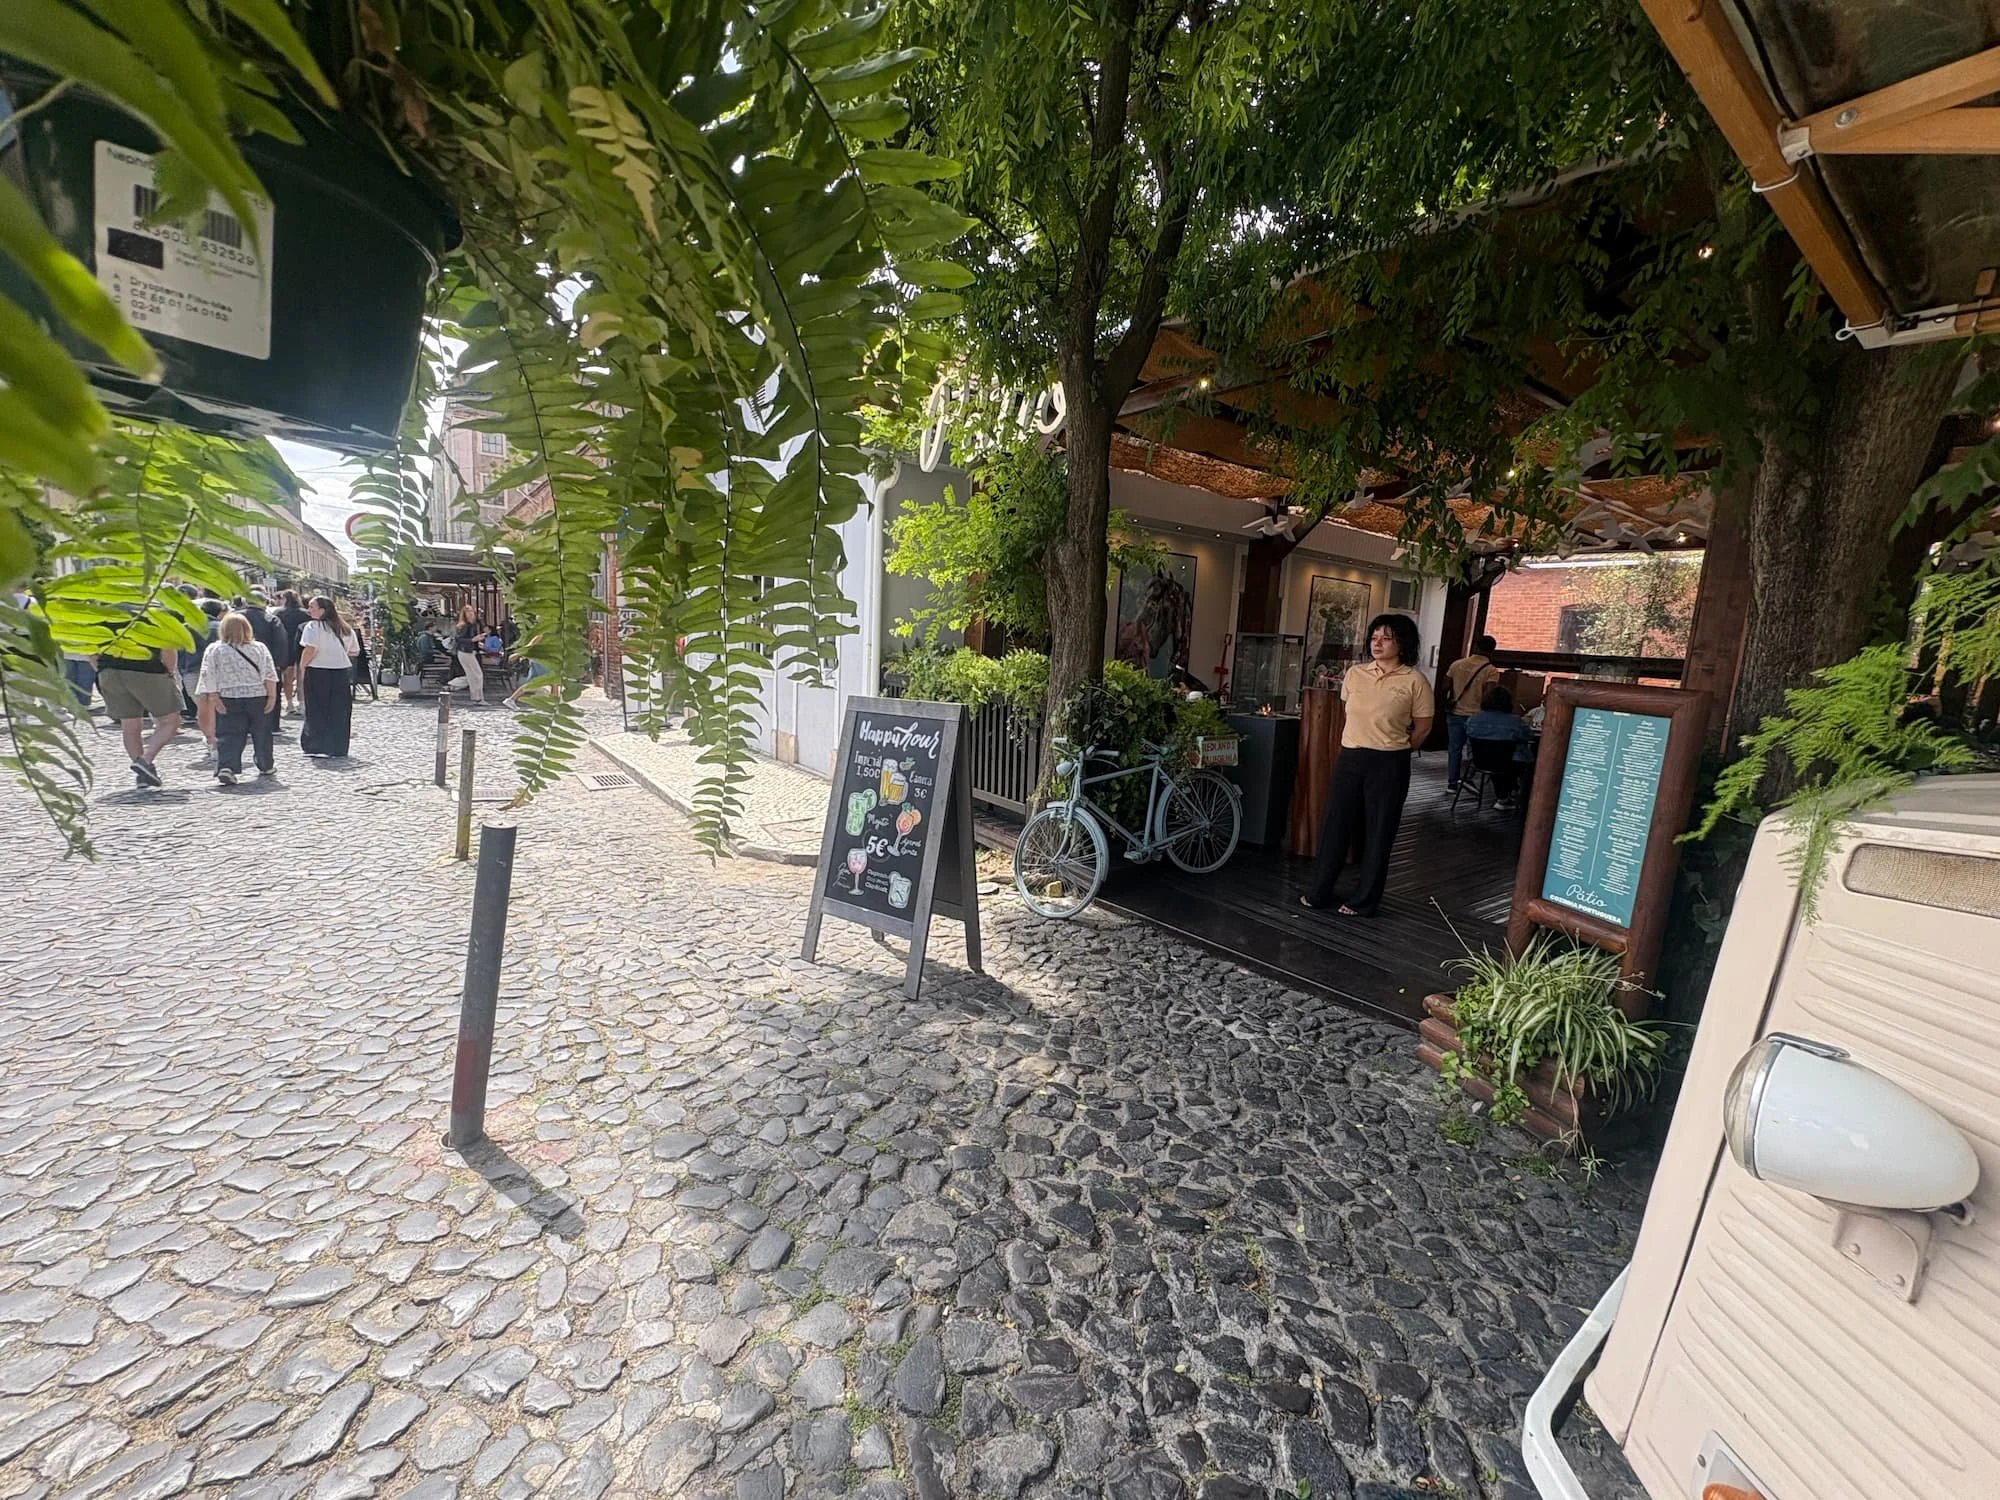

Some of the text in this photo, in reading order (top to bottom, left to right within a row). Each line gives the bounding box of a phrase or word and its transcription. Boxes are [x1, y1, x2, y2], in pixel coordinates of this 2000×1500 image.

[859, 720, 940, 760] Happy hour
[913, 787, 928, 799] 3€
[865, 835, 889, 857] 5€
